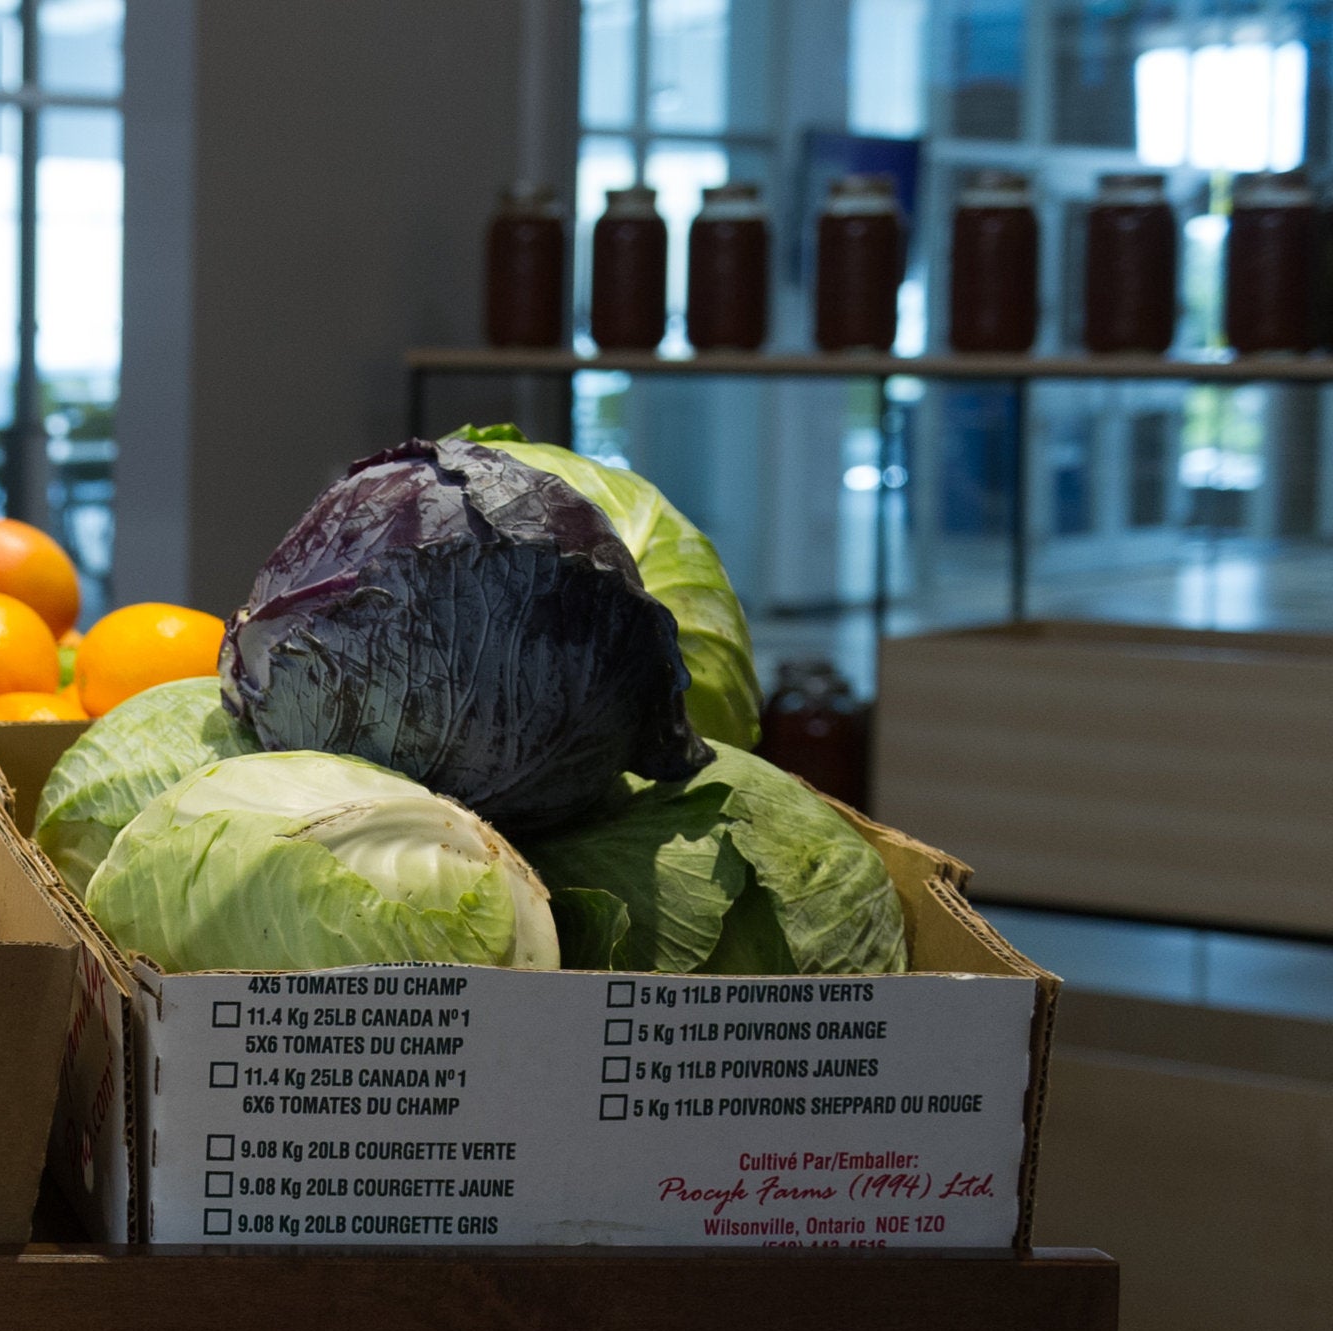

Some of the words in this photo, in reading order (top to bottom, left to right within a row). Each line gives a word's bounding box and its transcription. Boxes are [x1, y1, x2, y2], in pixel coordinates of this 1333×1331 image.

[248, 976, 282, 994] 4X5
[286, 976, 368, 995] TOMATES
[374, 977, 398, 995] DU
[404, 977, 467, 995] CHAMP
[656, 986, 677, 1008] Kg
[682, 986, 721, 1004] 11LB
[727, 984, 814, 1003] POIVRONS
[819, 983, 873, 1002] VERTS
[247, 1007, 282, 1025] 11.4
[288, 1008, 308, 1029] Kg
[314, 1008, 356, 1026] 25LB
[362, 1008, 433, 1027] CANADA
[654, 1024, 674, 1045] Kg
[680, 1023, 718, 1041] 11LB
[724, 1022, 811, 1041] POIVRONS
[816, 1021, 887, 1040] ORANGE
[246, 1035, 277, 1053] 5X6
[283, 1035, 365, 1054] TOMATES
[371, 1037, 395, 1055] DU
[400, 1037, 463, 1055] CHAMP
[245, 1067, 279, 1086] 11.4
[285, 1068, 306, 1090] Kg
[310, 1068, 353, 1086] 25LB
[359, 1069, 429, 1087] CANADA
[651, 1061, 672, 1083] Kg
[677, 1061, 716, 1079] 11LB
[721, 1059, 808, 1078] POIVRONS
[813, 1058, 878, 1077] JAUNES
[243, 1096, 274, 1114] 6X6
[279, 1096, 361, 1115] TOMATES
[367, 1097, 391, 1115] DU
[397, 1097, 460, 1115] CHAMP
[649, 1099, 669, 1121] Kg
[675, 1098, 713, 1116] 11LB
[719, 1097, 806, 1116] POIVRONS
[811, 1096, 896, 1115] SHEPPARD
[901, 1095, 923, 1114] OU
[928, 1094, 982, 1113] ROUGE
[241, 1140, 277, 1158] 9.08
[282, 1141, 303, 1162] Kg
[308, 1141, 350, 1159] 20LB
[355, 1141, 457, 1160] COURGETTE
[462, 1142, 516, 1160] VERTE
[739, 1152, 797, 1171] Cultivé
[803, 1151, 918, 1171] Par/Emballer:
[239, 1177, 275, 1195] 9.08
[306, 1178, 348, 1196] 20LB
[354, 1178, 455, 1197] COURGETTE
[459, 1179, 514, 1197] JAUNE
[658, 1177, 748, 1216] Procyk
[756, 1176, 837, 1206] Farms
[849, 1173, 932, 1200] (1994)
[939, 1172, 994, 1199] Ltd.
[238, 1214, 274, 1233] 9.08
[305, 1215, 346, 1233] 20LB
[352, 1215, 453, 1234] COURGETTE
[458, 1216, 498, 1234] GRIS
[704, 1218, 799, 1236] Wilsonville,
[806, 1217, 865, 1235] Ontario
